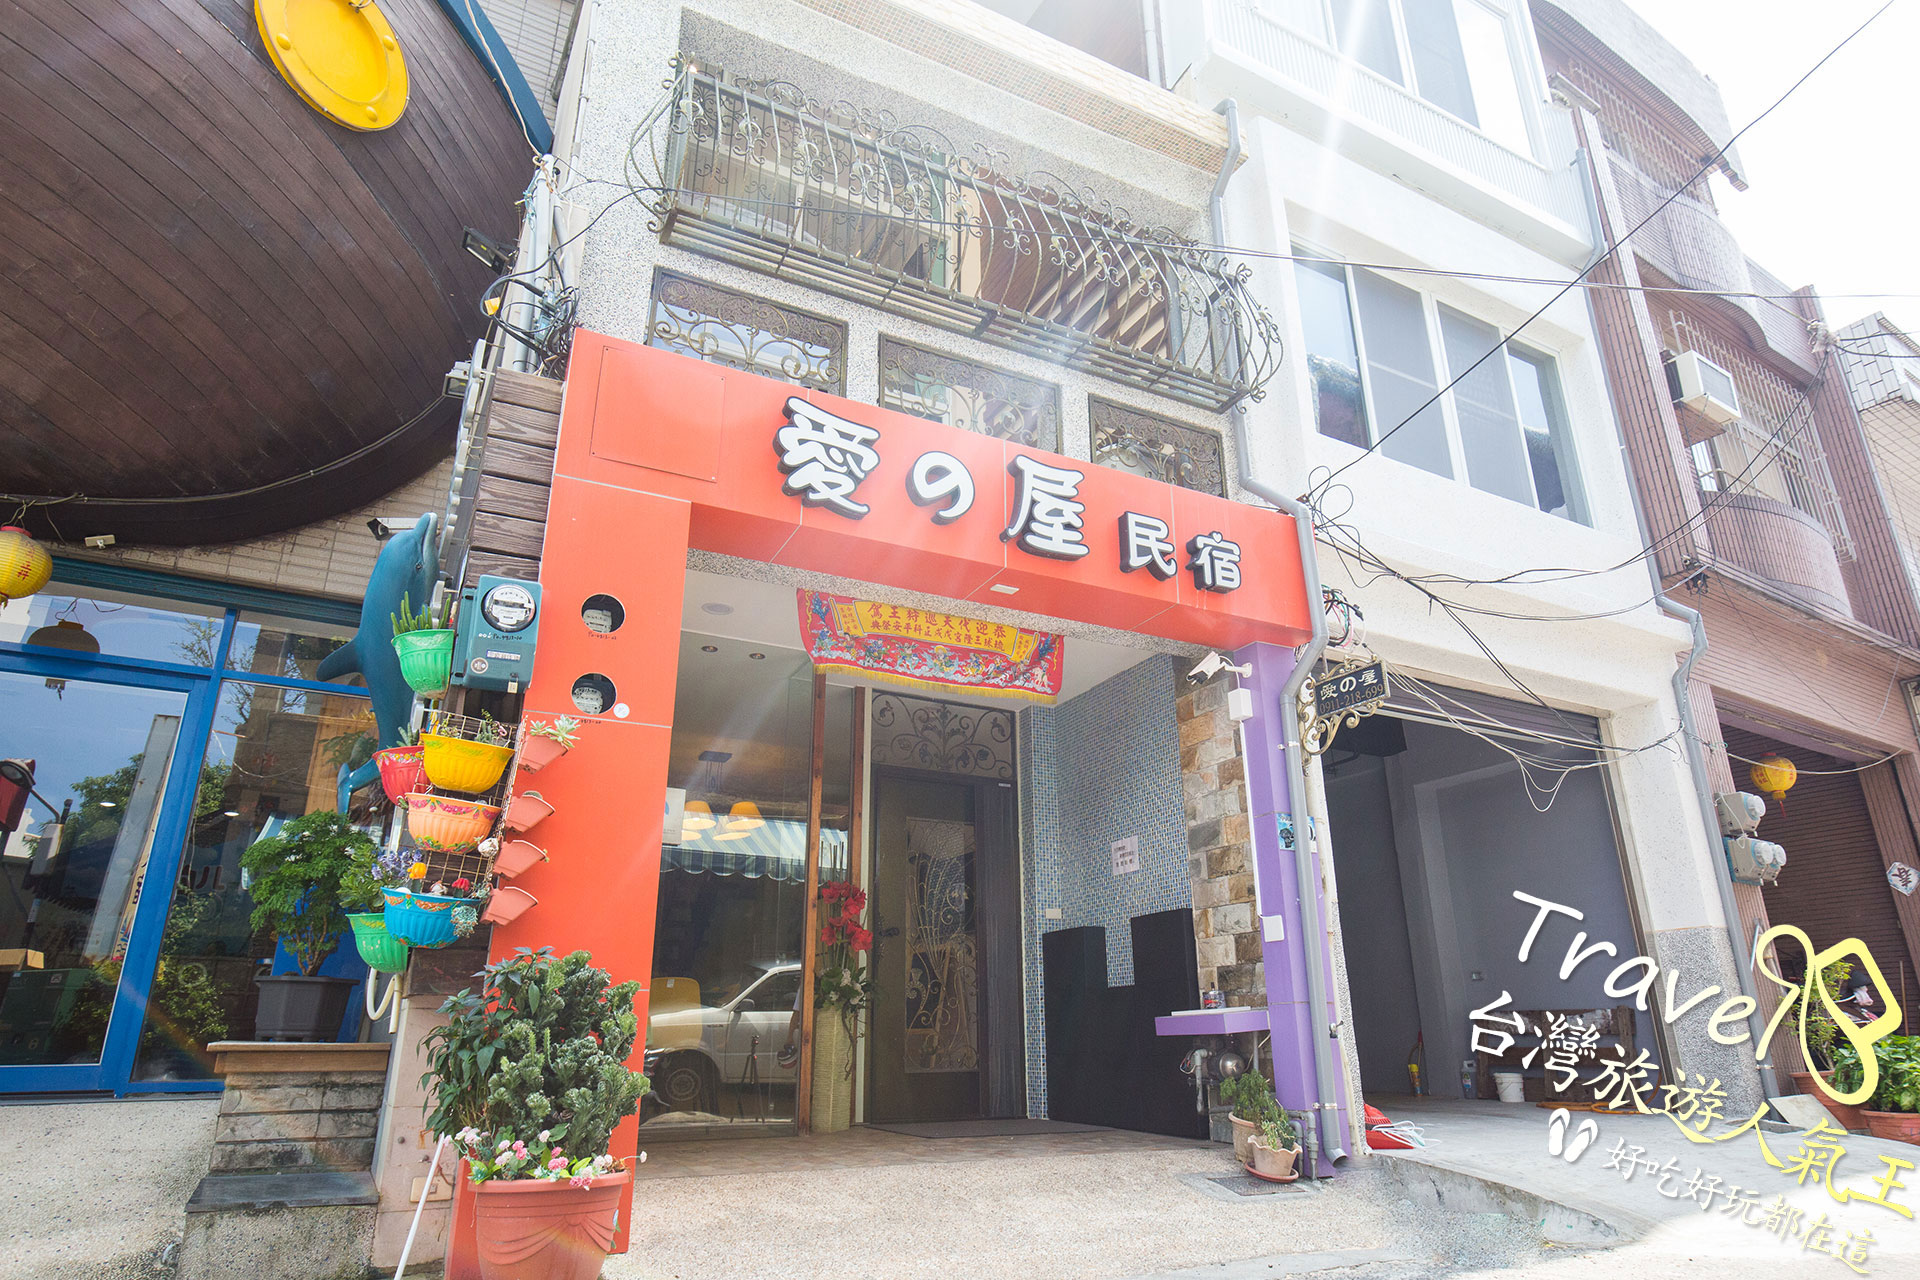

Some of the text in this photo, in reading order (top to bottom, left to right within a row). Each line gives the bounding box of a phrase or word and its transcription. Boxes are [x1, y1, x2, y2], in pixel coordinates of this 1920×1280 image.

[772, 396, 1241, 594] 愛の屋民宿
[1320, 669, 1378, 700] 愛の屋
[1320, 683, 1384, 714] 0911-218-699
[1891, 867, 1912, 887] 春
